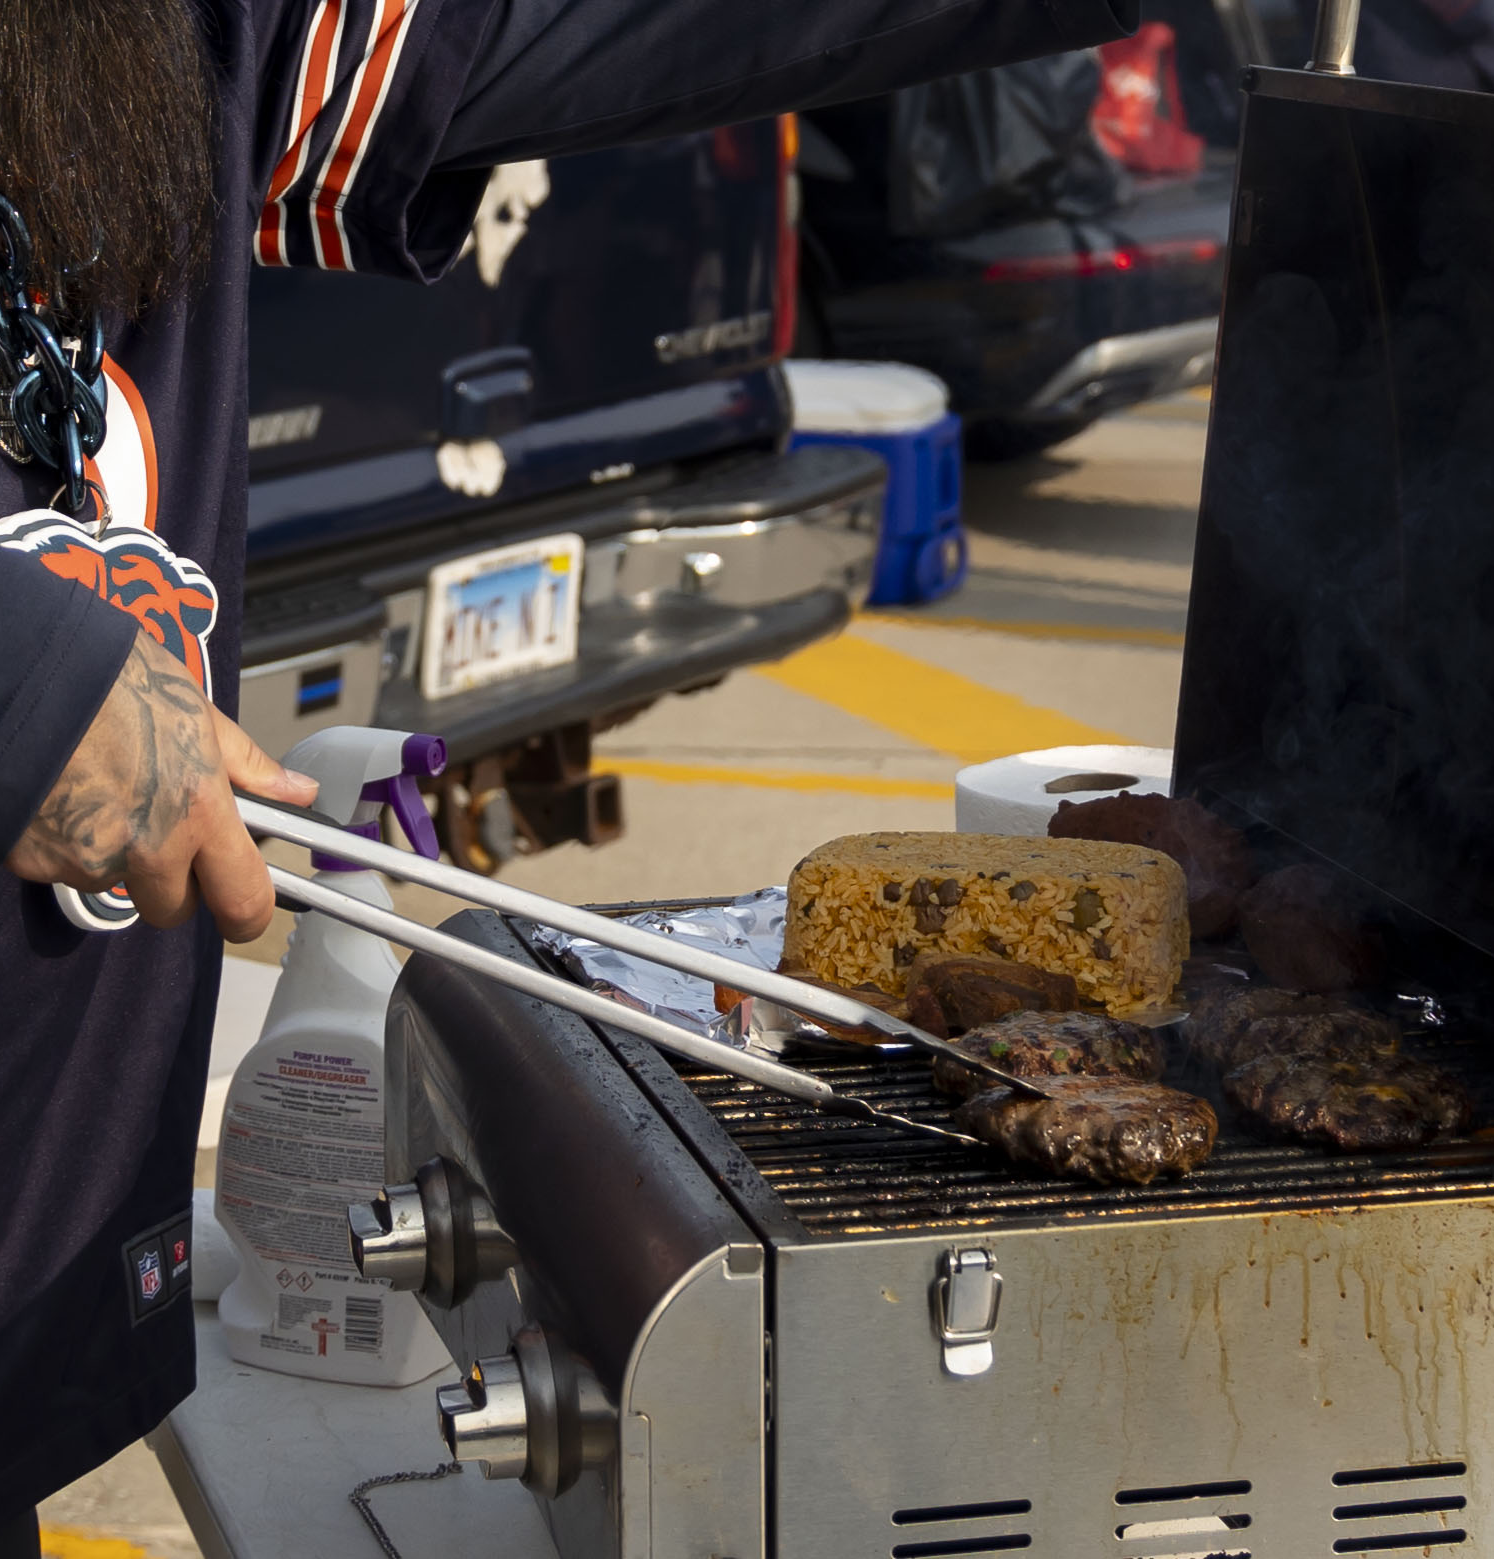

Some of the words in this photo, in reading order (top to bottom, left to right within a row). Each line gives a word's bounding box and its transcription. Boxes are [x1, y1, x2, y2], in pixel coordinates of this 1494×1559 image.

[293, 1051, 323, 1063] PURPLE
[324, 1055, 353, 1066] POWER
[278, 1065, 367, 1085] CLEANER/DEGREASER
